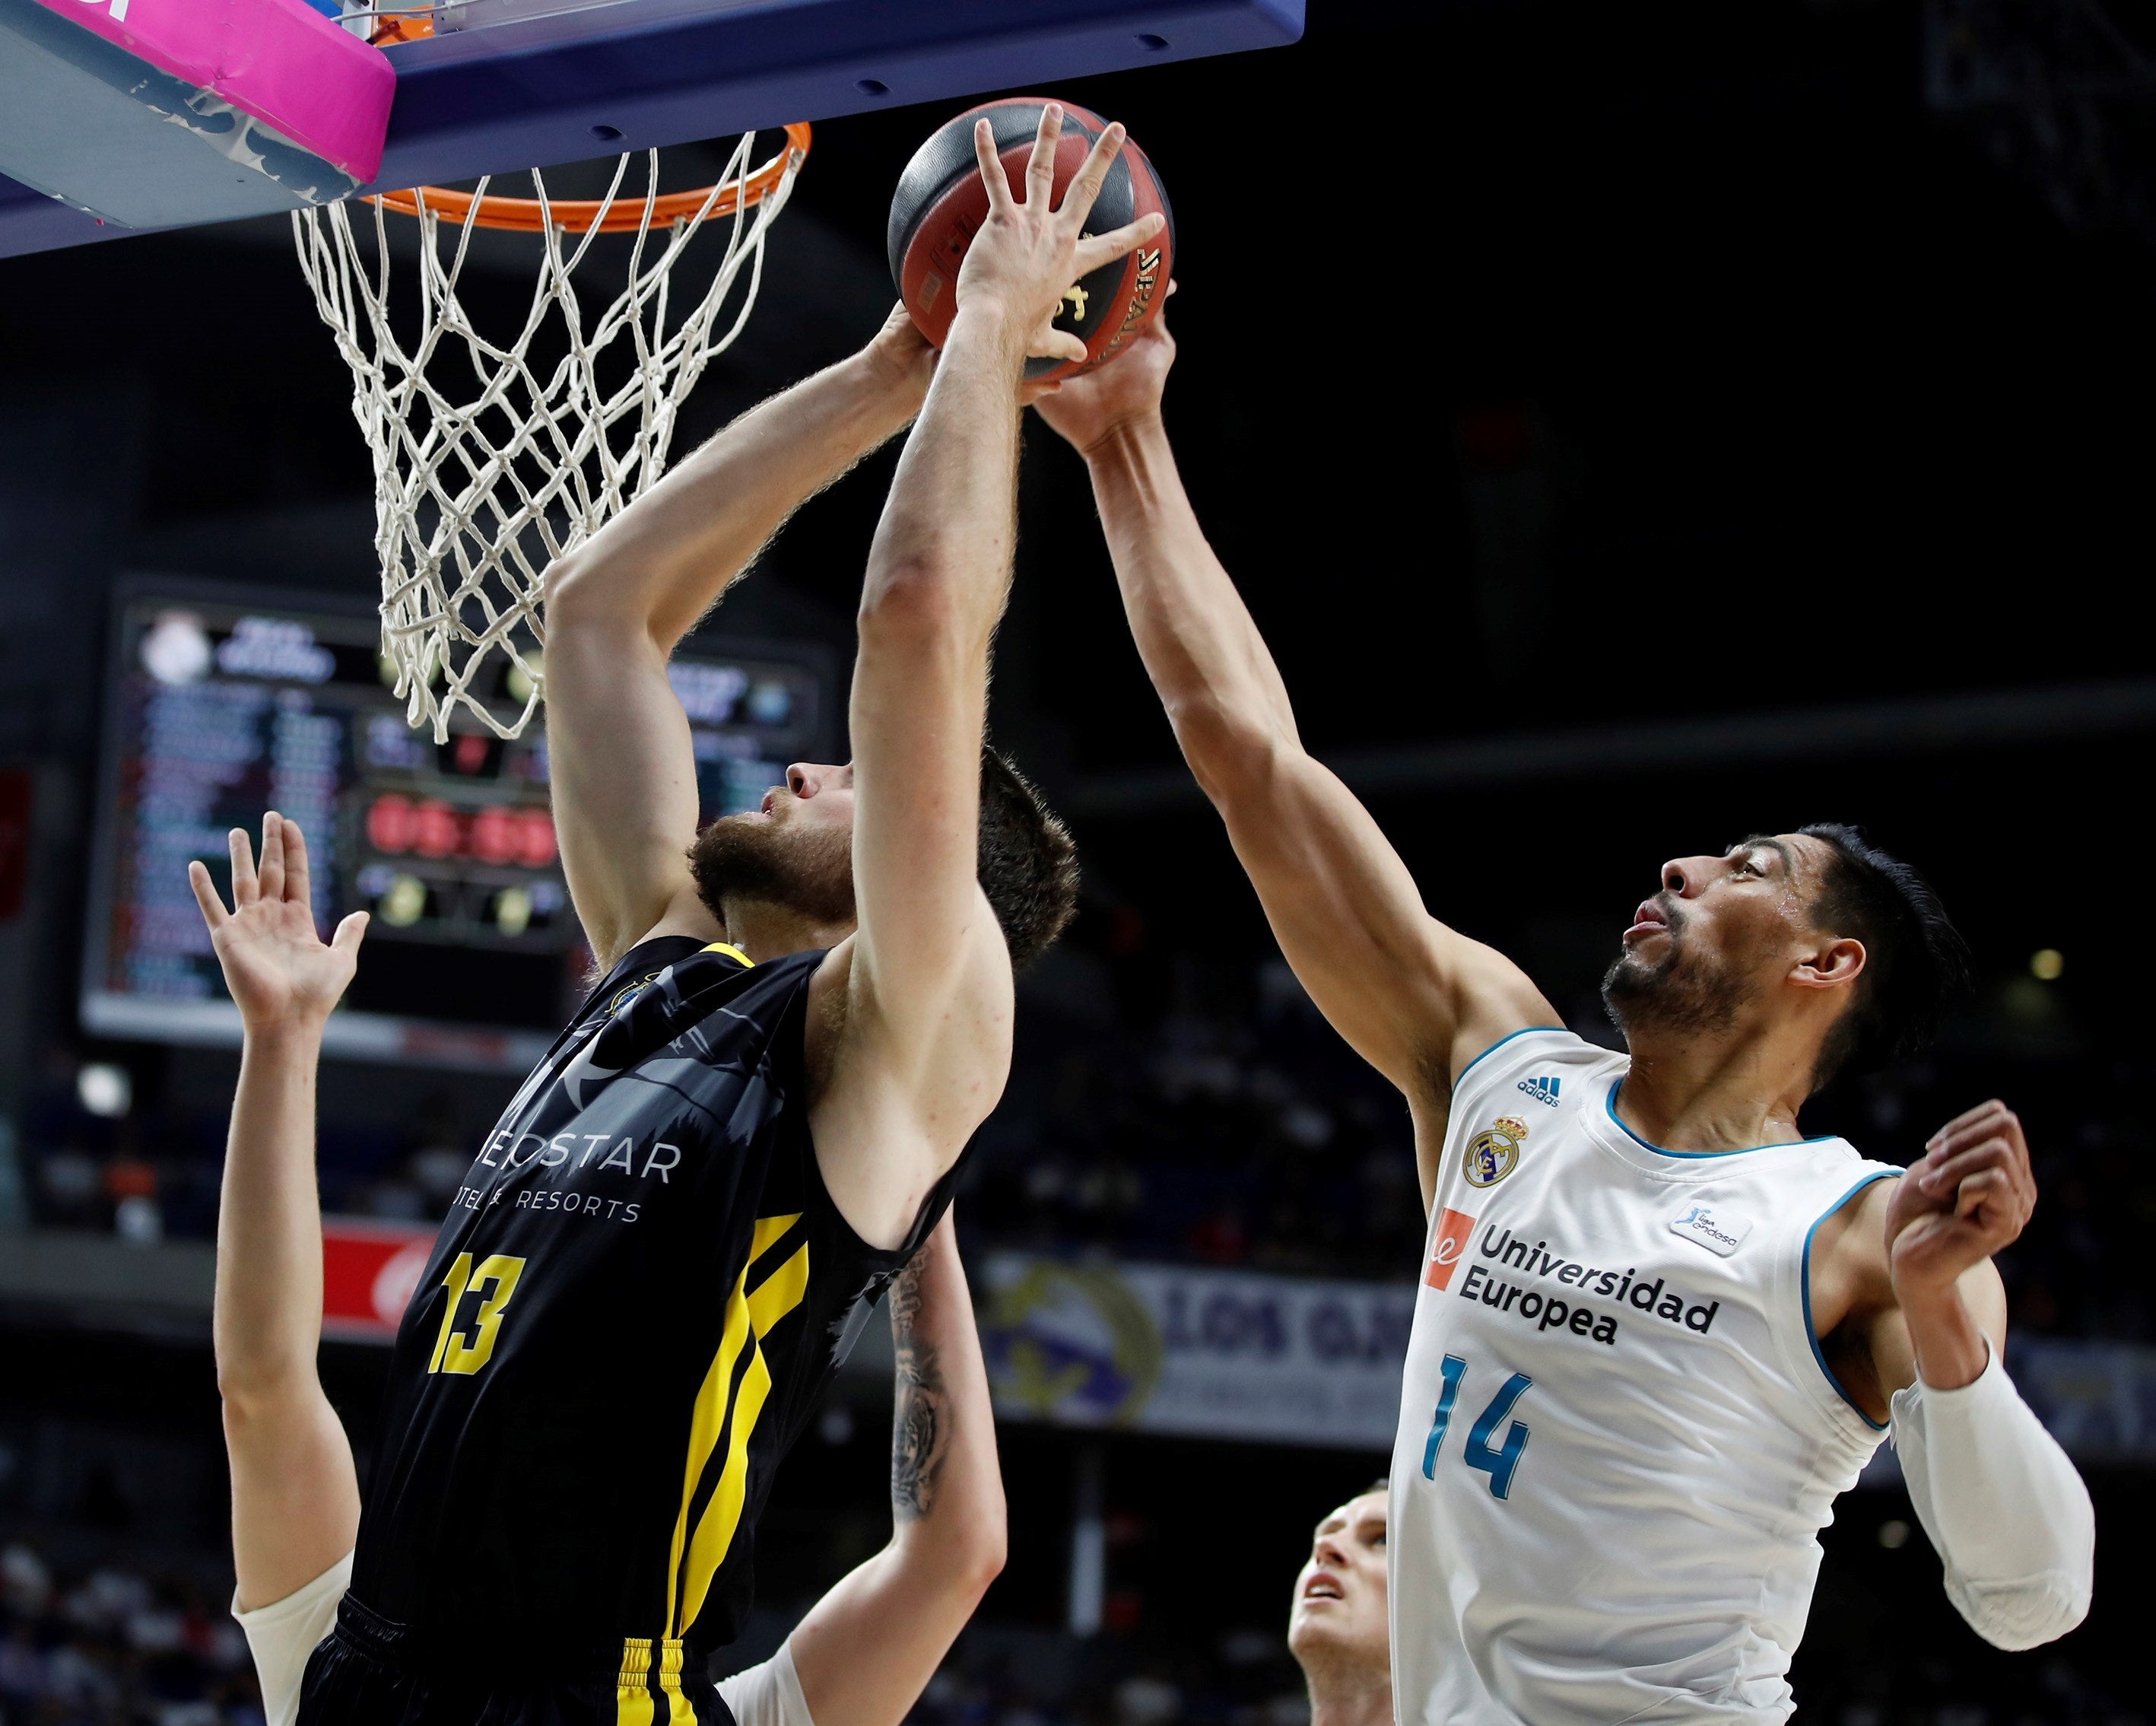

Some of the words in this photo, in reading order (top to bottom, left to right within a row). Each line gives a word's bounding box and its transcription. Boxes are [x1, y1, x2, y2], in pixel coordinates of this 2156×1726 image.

[1517, 1081, 1561, 1108] adidas
[515, 1190, 641, 1223] RESORTS
[1692, 1222, 1737, 1247] endesa
[1698, 1213, 1716, 1228] liga
[1459, 1265, 1618, 1346] Europea
[1481, 1223, 1719, 1335] Universidad
[427, 1251, 527, 1376] 13
[1421, 1353, 1533, 1501] 14
